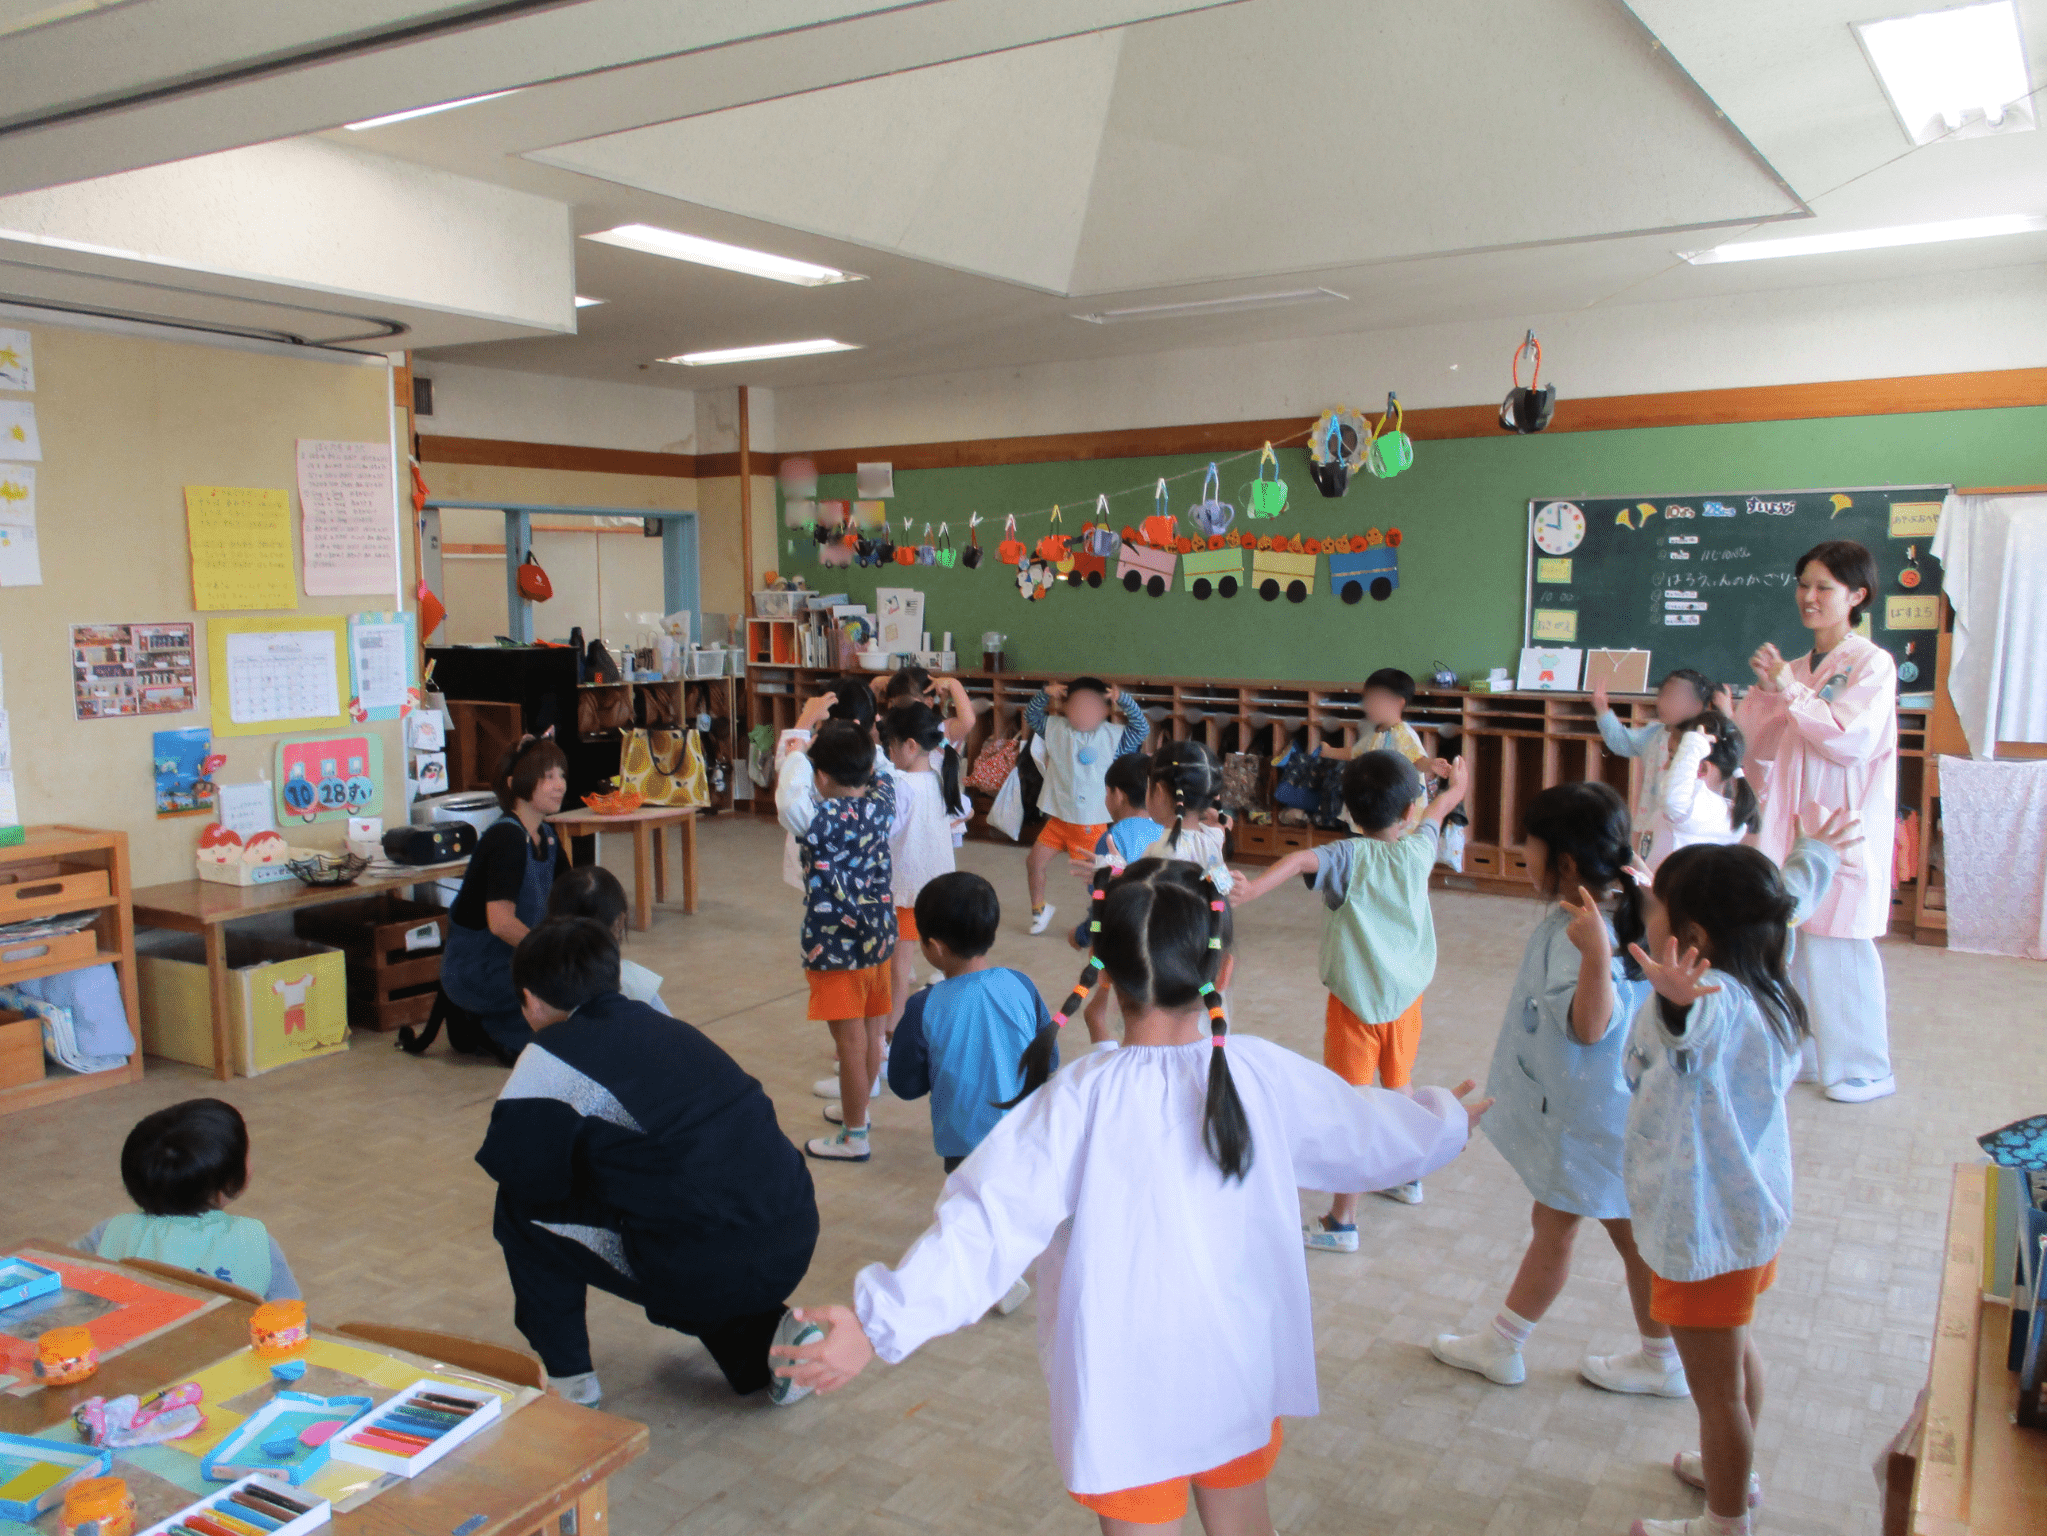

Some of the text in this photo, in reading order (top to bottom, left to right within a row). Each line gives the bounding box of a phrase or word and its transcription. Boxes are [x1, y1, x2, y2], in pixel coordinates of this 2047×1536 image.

[287, 783, 373, 808] 10 28 すい
